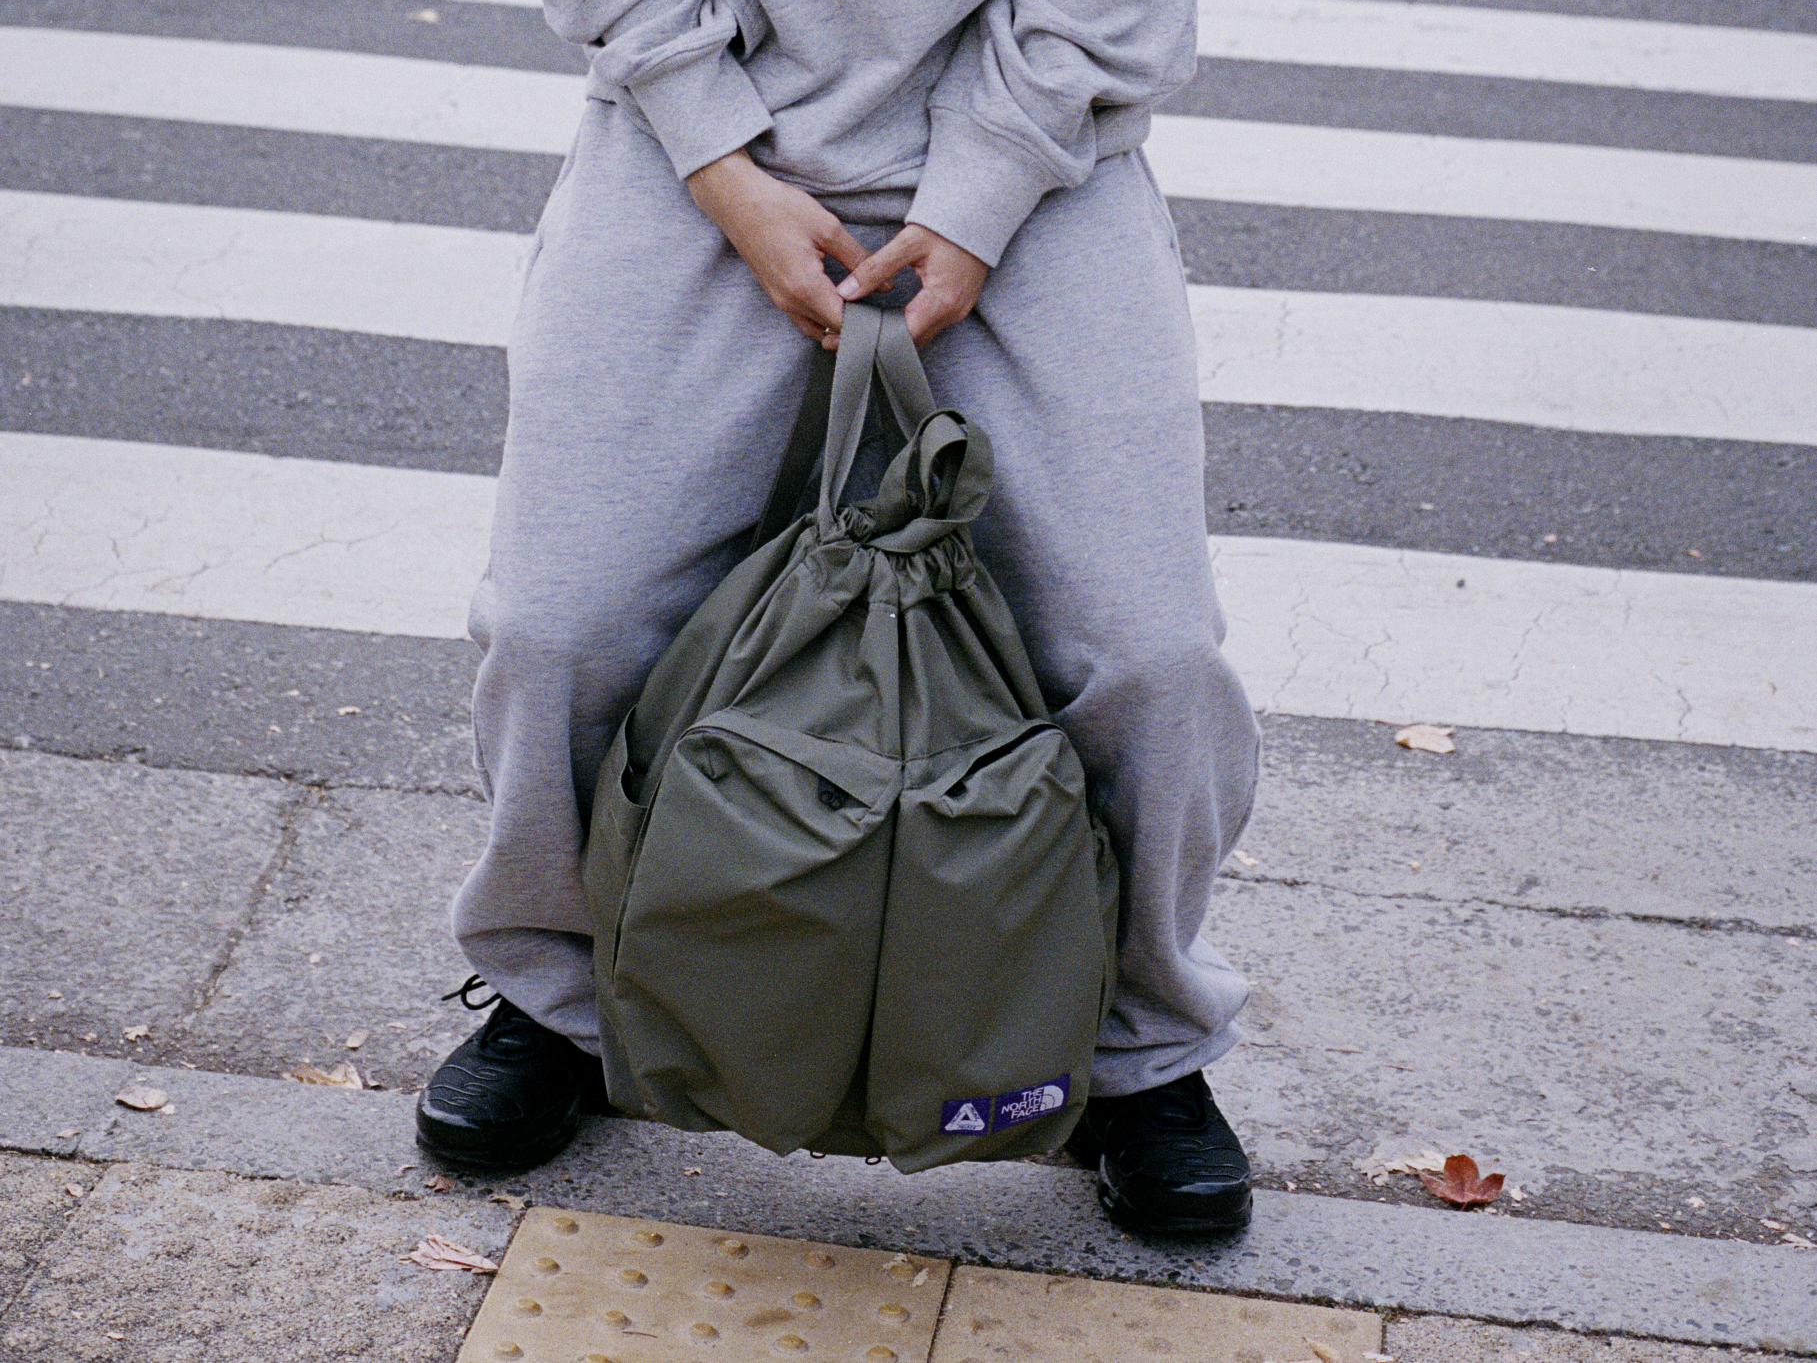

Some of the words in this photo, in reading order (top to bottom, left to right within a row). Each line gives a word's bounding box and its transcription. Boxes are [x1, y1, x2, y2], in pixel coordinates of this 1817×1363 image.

[1022, 1087, 1043, 1101] THE
[1001, 1095, 1042, 1114] NORTH
[1011, 1104, 1039, 1119] FACE
